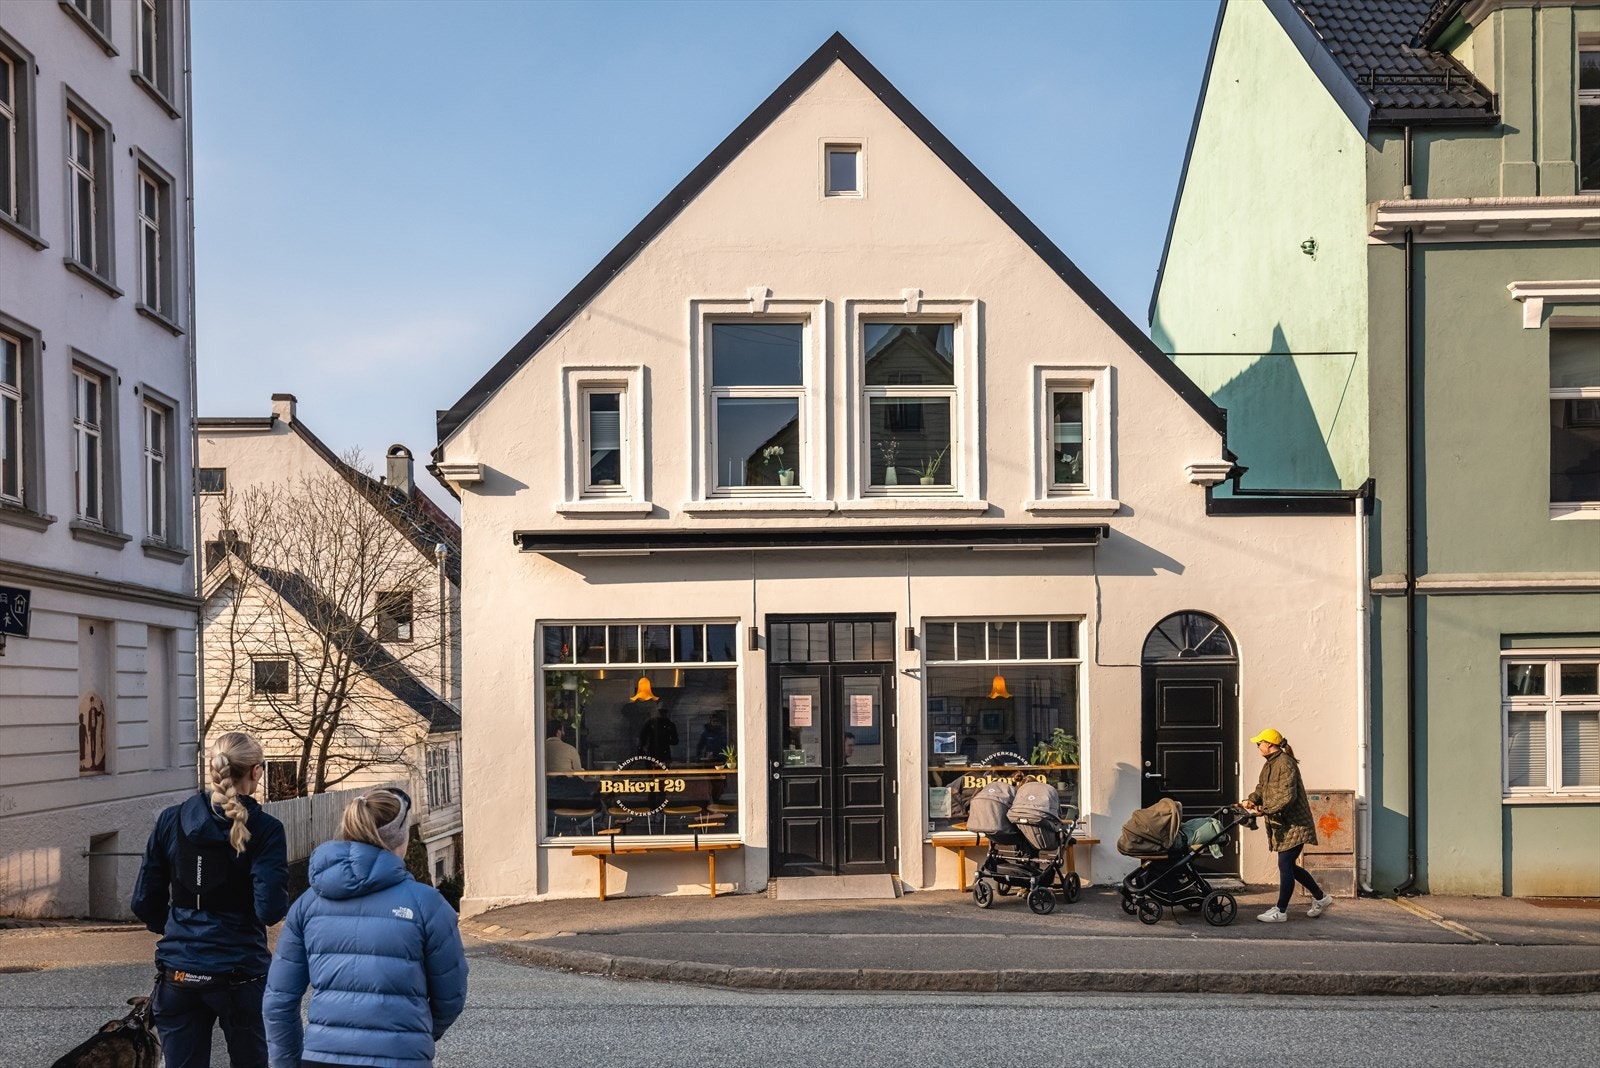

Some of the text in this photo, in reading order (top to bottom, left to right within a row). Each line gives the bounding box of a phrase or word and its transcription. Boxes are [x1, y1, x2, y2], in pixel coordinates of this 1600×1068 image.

[600, 778, 686, 793] Bakeri 29
[616, 798, 669, 817] SKUTEVIKSVEIEN
[185, 973, 212, 981] Non-stop
